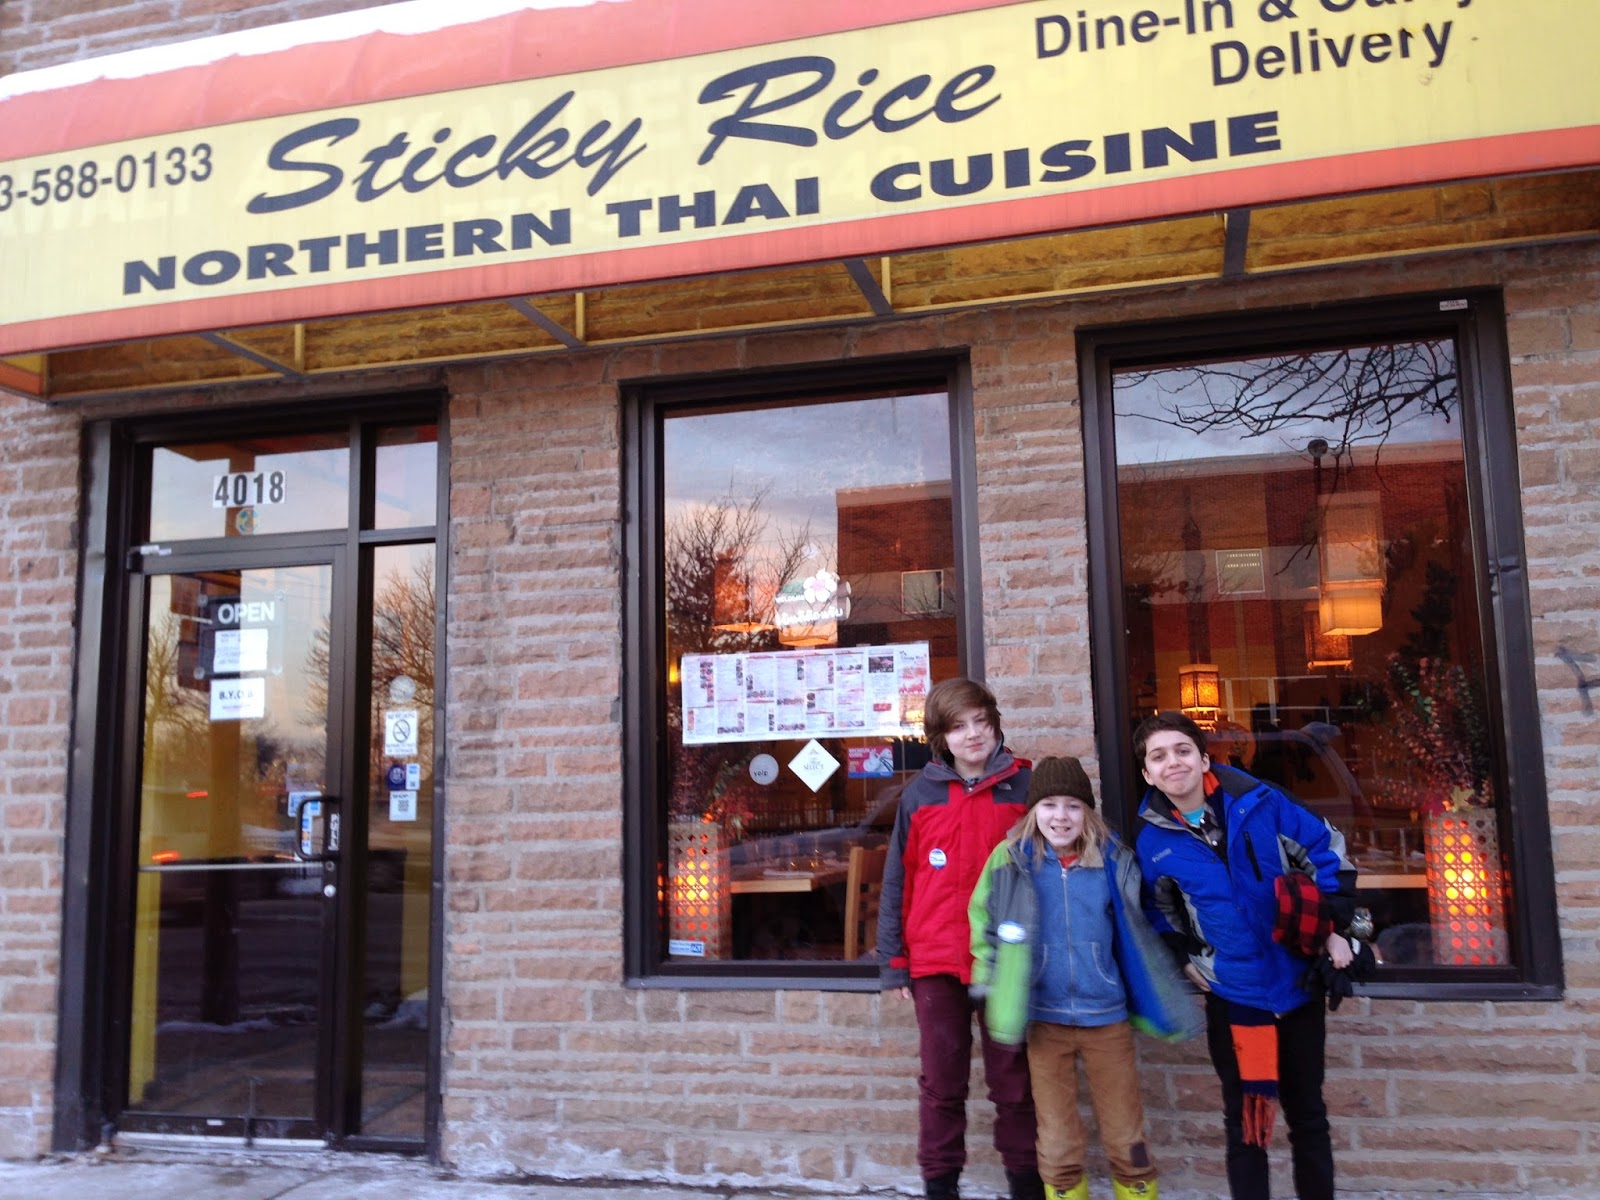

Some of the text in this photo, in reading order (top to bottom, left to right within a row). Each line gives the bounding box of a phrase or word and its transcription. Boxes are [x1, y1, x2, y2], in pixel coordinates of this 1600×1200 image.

[1036, 0, 1234, 59] Dine-In
[1211, 20, 1453, 86] Delivery
[246, 57, 1002, 214] Sticky Rice
[123, 111, 1282, 295] NORTHERN THAI CUISINE
[215, 471, 284, 506] 4018
[218, 601, 275, 625] OPEN
